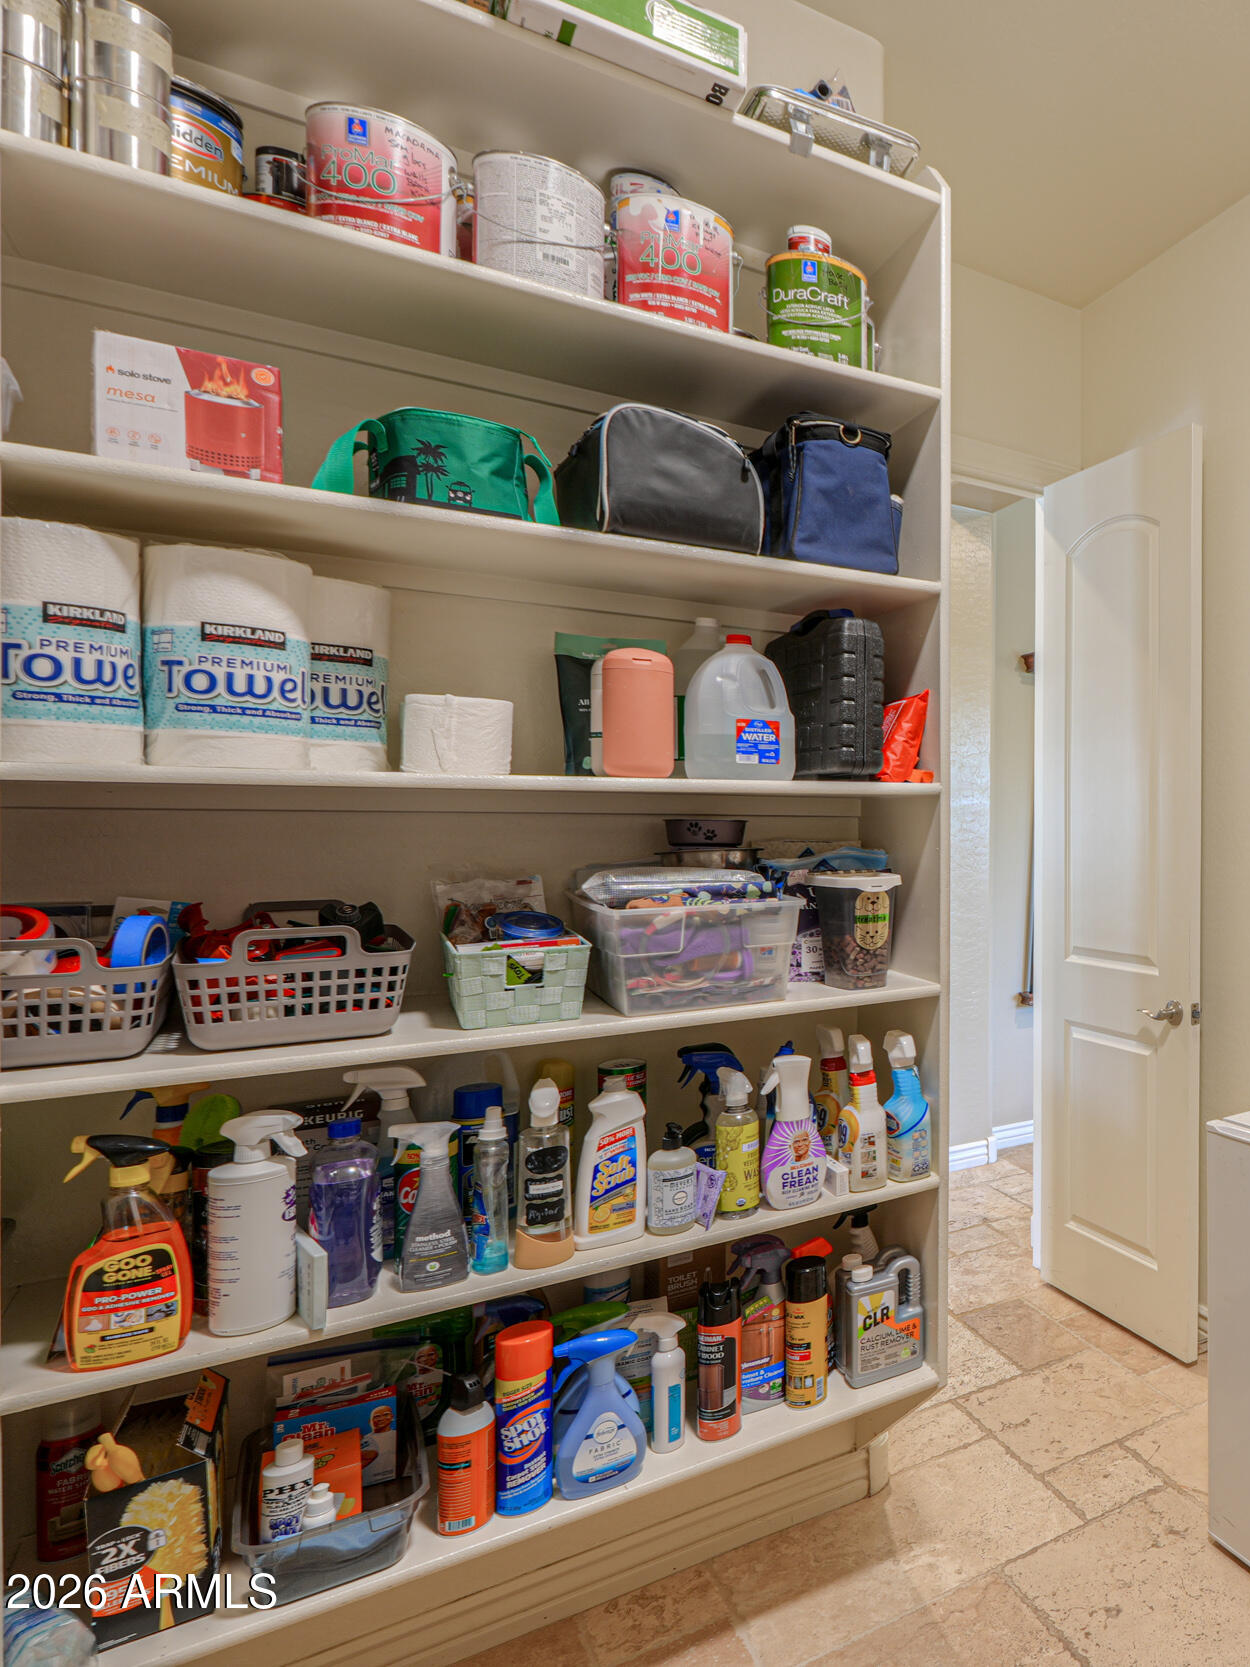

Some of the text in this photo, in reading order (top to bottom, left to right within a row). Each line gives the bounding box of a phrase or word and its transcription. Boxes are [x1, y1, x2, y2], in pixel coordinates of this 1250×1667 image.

[321, 143, 394, 170] ProMar
[320, 160, 397, 196] 400
[640, 245, 702, 275] 400
[772, 287, 848, 311] DuraCraft
[117, 368, 171, 384] solo stove
[106, 386, 155, 403] mesa
[205, 623, 284, 643] KIRKLAND
[40, 638, 131, 659] PREMIUM
[198, 655, 288, 674] PREMIUM
[161, 659, 307, 706] Towel
[61, 694, 92, 704] Thick
[216, 705, 242, 715] Thick
[245, 708, 262, 716] and
[315, 717, 336, 725] Thick
[742, 732, 776, 742] WATER
[806, 945, 818, 954] 30
[599, 1155, 631, 1176] Soft
[782, 1165, 819, 1181] CLEAN
[591, 1163, 636, 1197] Scrub
[782, 1176, 819, 1190] FREAK
[416, 1229, 451, 1242] method
[104, 1254, 152, 1272] GOO
[102, 1265, 152, 1283] GONE
[667, 1271, 697, 1284] TOILET
[667, 1279, 698, 1291] BRUSH
[94, 1287, 162, 1304] PRO-POWER
[862, 1305, 890, 1331] CLR
[860, 1332, 894, 1345] CALCIUM,
[896, 1324, 911, 1335] LIME
[860, 1332, 914, 1352] RUST REMOVER
[301, 1421, 330, 1434] Mr.
[588, 1440, 622, 1455] FABRIC
[101, 1538, 142, 1566] 2X
[95, 1552, 146, 1574] FIBERS
